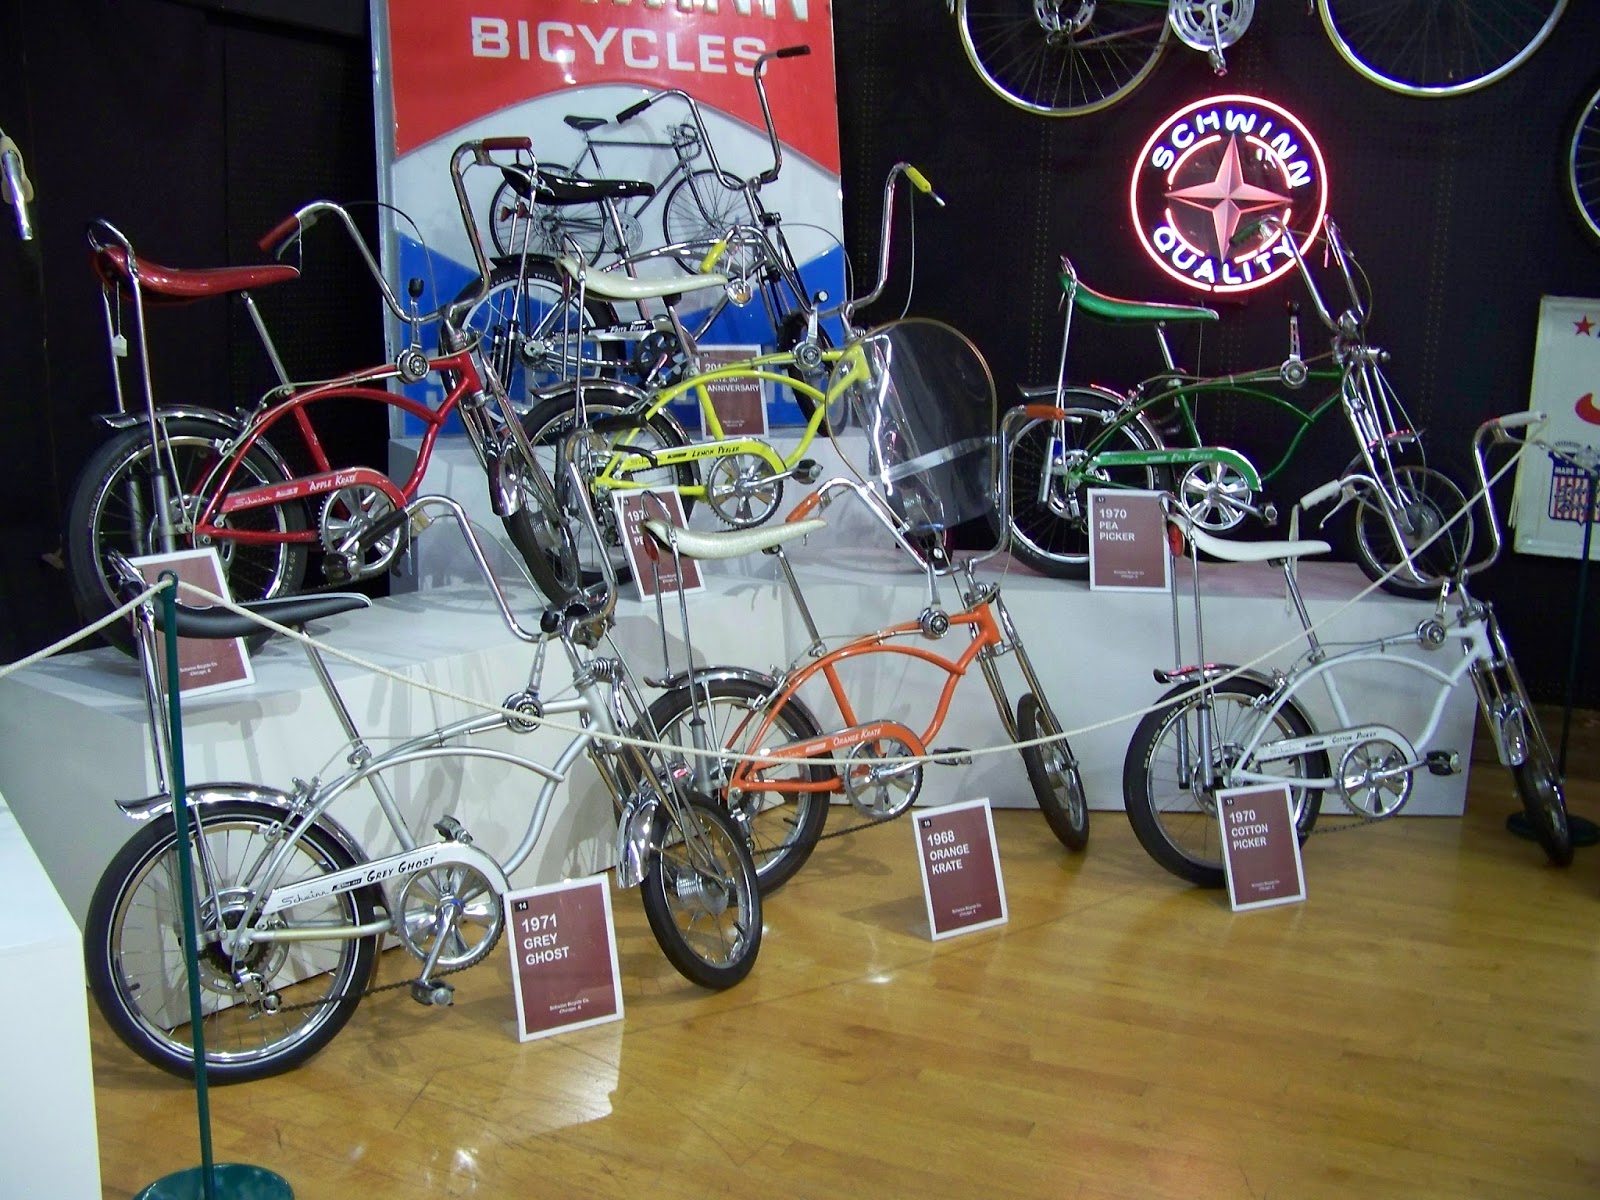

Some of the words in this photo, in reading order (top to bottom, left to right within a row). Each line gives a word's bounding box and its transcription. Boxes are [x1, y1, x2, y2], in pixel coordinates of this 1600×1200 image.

[470, 16, 768, 77] BICYCLES
[1152, 110, 1311, 188] SCHWINN
[1153, 225, 1297, 285] QUALITY
[707, 384, 760, 393] ANNIVERSARY
[1099, 508, 1128, 519] 1970
[1099, 521, 1119, 530] PEA
[1099, 532, 1136, 541] PICKER
[1229, 809, 1256, 824] 1970
[1231, 823, 1269, 837] COTTON
[927, 830, 955, 847] 1968
[1233, 836, 1267, 851] PICKER
[929, 843, 970, 861] ORANGE
[931, 859, 963, 875] KRATE
[518, 902, 527, 911] 14
[521, 913, 558, 933] 1971
[523, 932, 558, 950] GREY
[525, 946, 570, 966] GHOST
